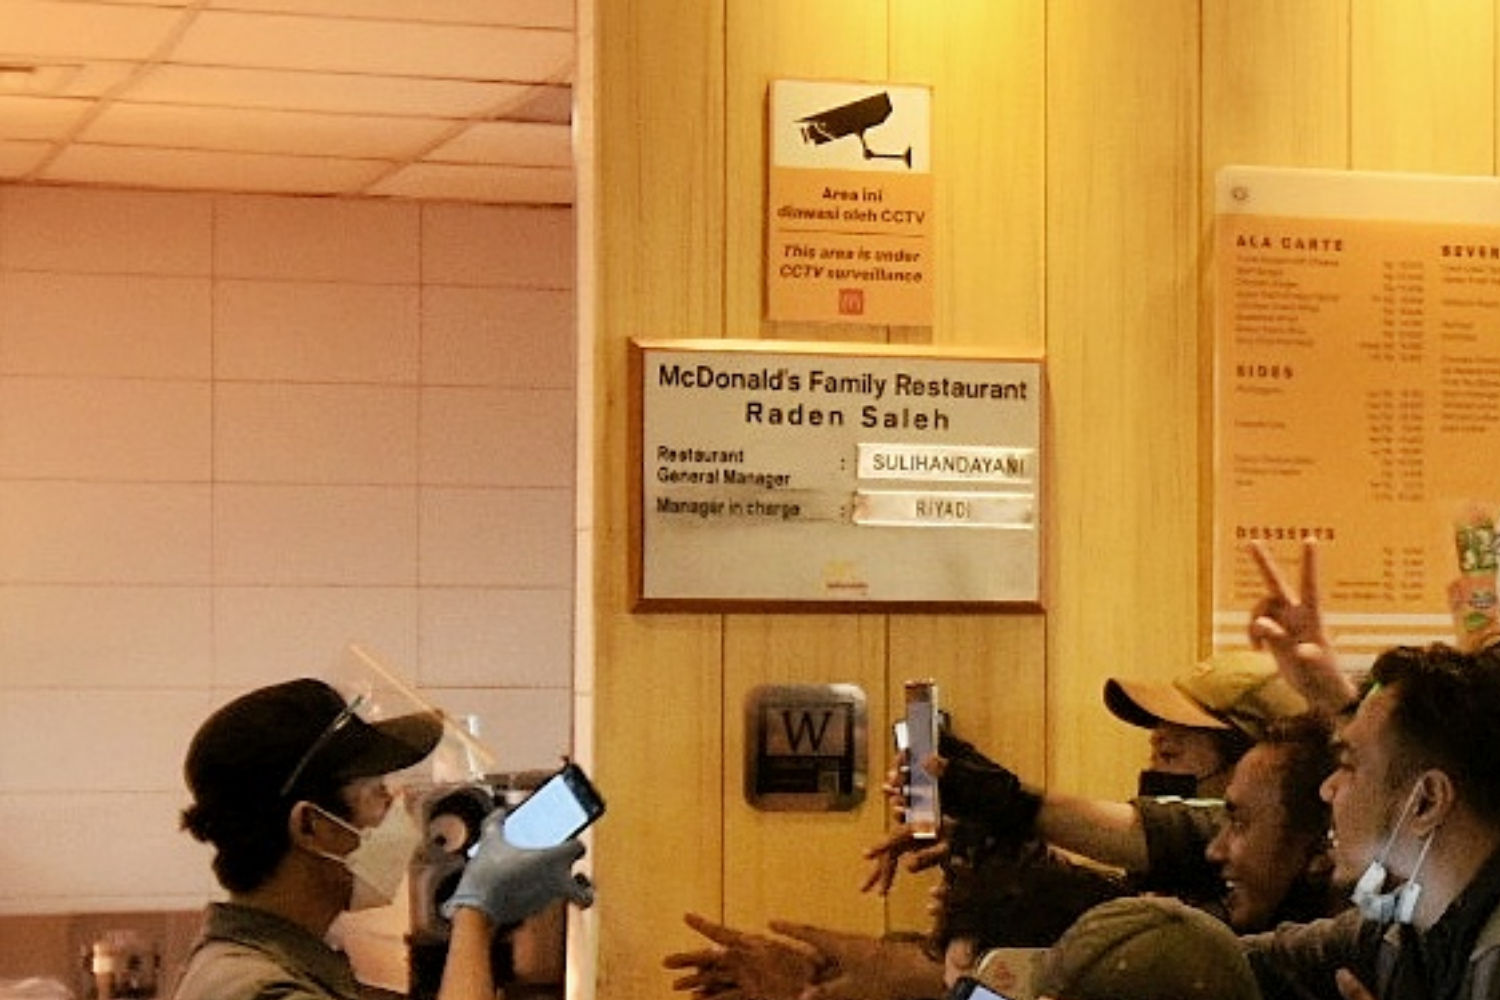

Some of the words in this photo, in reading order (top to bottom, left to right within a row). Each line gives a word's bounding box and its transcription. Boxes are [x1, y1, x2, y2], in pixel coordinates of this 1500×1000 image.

[822, 186, 858, 201] Area
[862, 187, 882, 202] ini
[777, 205, 839, 220] diawasi
[843, 208, 877, 222] oleh
[881, 210, 925, 224] CCTV
[1236, 235, 1271, 249] ALA
[1281, 237, 1343, 252] CARTE
[784, 245, 815, 259] This
[820, 247, 853, 260] area
[858, 246, 871, 260] is
[876, 250, 920, 263] under
[779, 264, 824, 279] CCTV
[827, 266, 922, 283] surveillance
[658, 364, 800, 392] McDonald's
[808, 371, 886, 400] Family
[894, 374, 1028, 400] Restaurant
[1236, 365, 1293, 380] SIDES
[745, 402, 844, 427] Raden
[861, 405, 950, 430] Saleh
[657, 445, 744, 463] Restaurant
[872, 453, 1025, 476] SULIHANDAYANI
[657, 466, 719, 484] General
[723, 469, 790, 489] Manager
[657, 497, 724, 518] Manager
[729, 498, 743, 515] in
[745, 500, 800, 520] charge
[915, 500, 971, 519] RIYADI
[1236, 526, 1335, 541] DESSERTS
[782, 709, 832, 753] W
